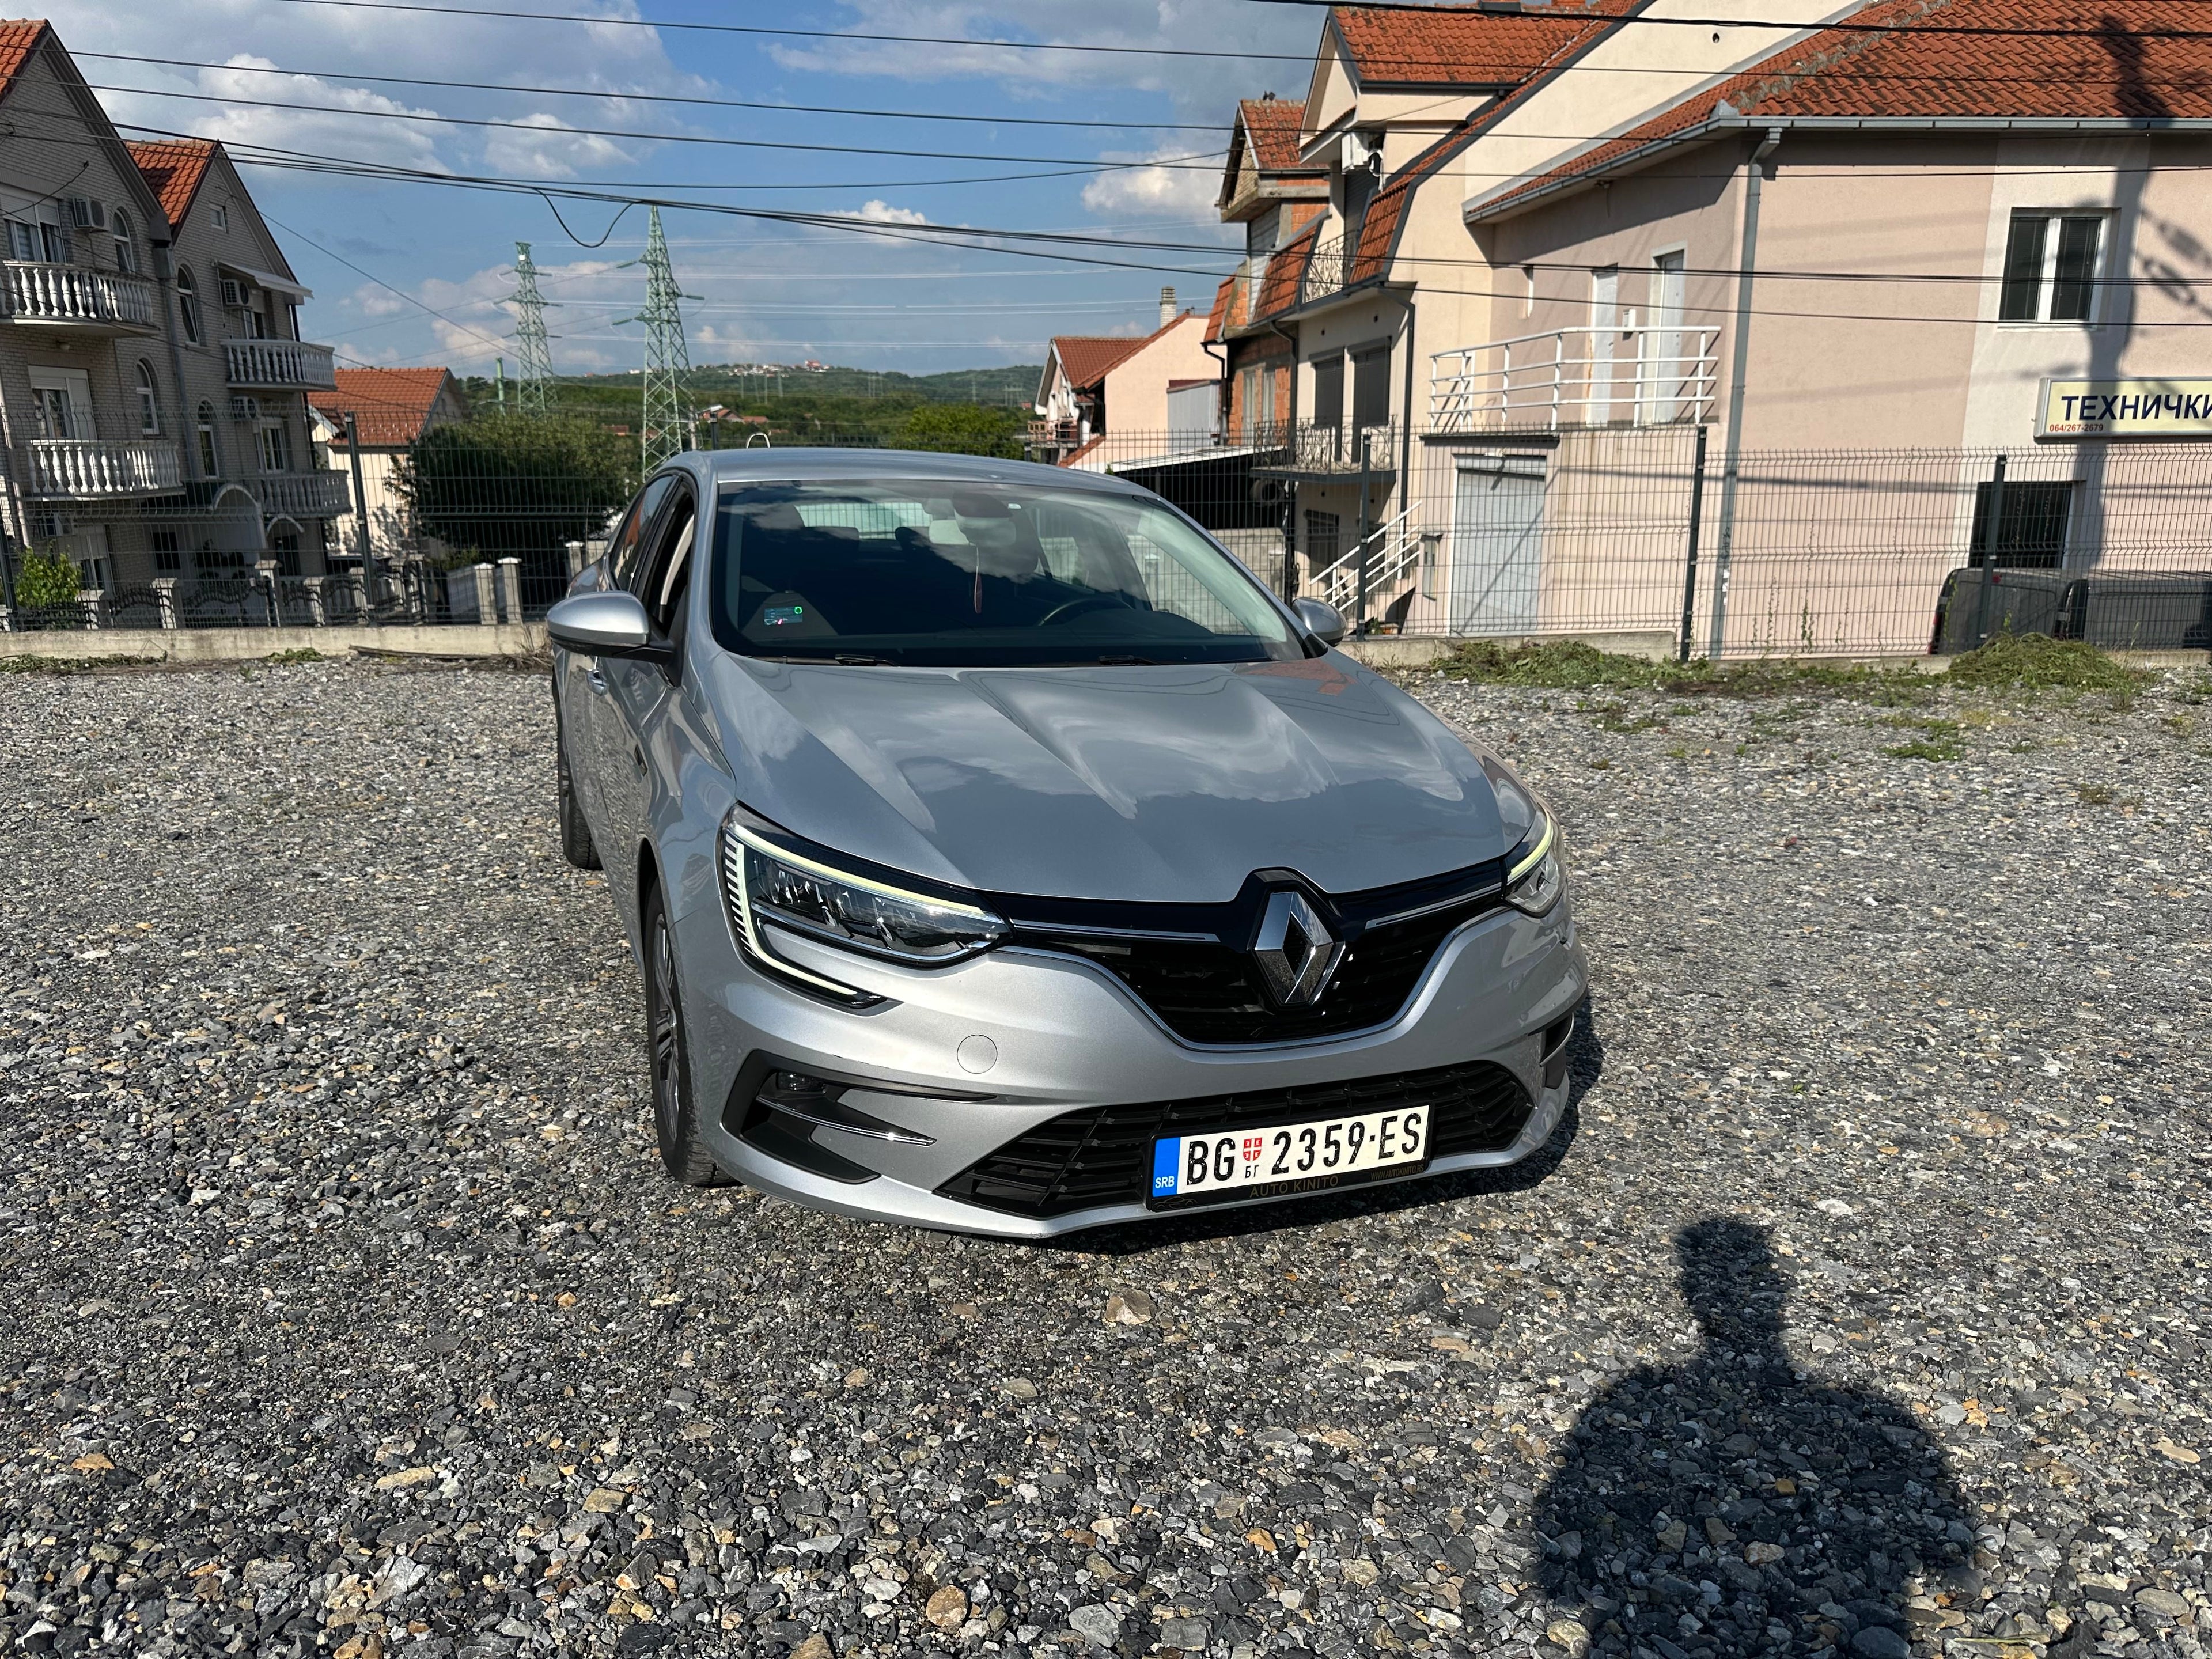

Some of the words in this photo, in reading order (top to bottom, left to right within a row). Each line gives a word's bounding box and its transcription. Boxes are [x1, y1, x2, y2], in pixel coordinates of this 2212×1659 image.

[2050, 423, 2104, 432] 064/267-2679
[1187, 1137, 1236, 1185] BG
[1155, 1176, 1175, 1189] SRB
[1249, 1182, 1289, 1198] AUTO
[1294, 1175, 1339, 1192] KINITO
